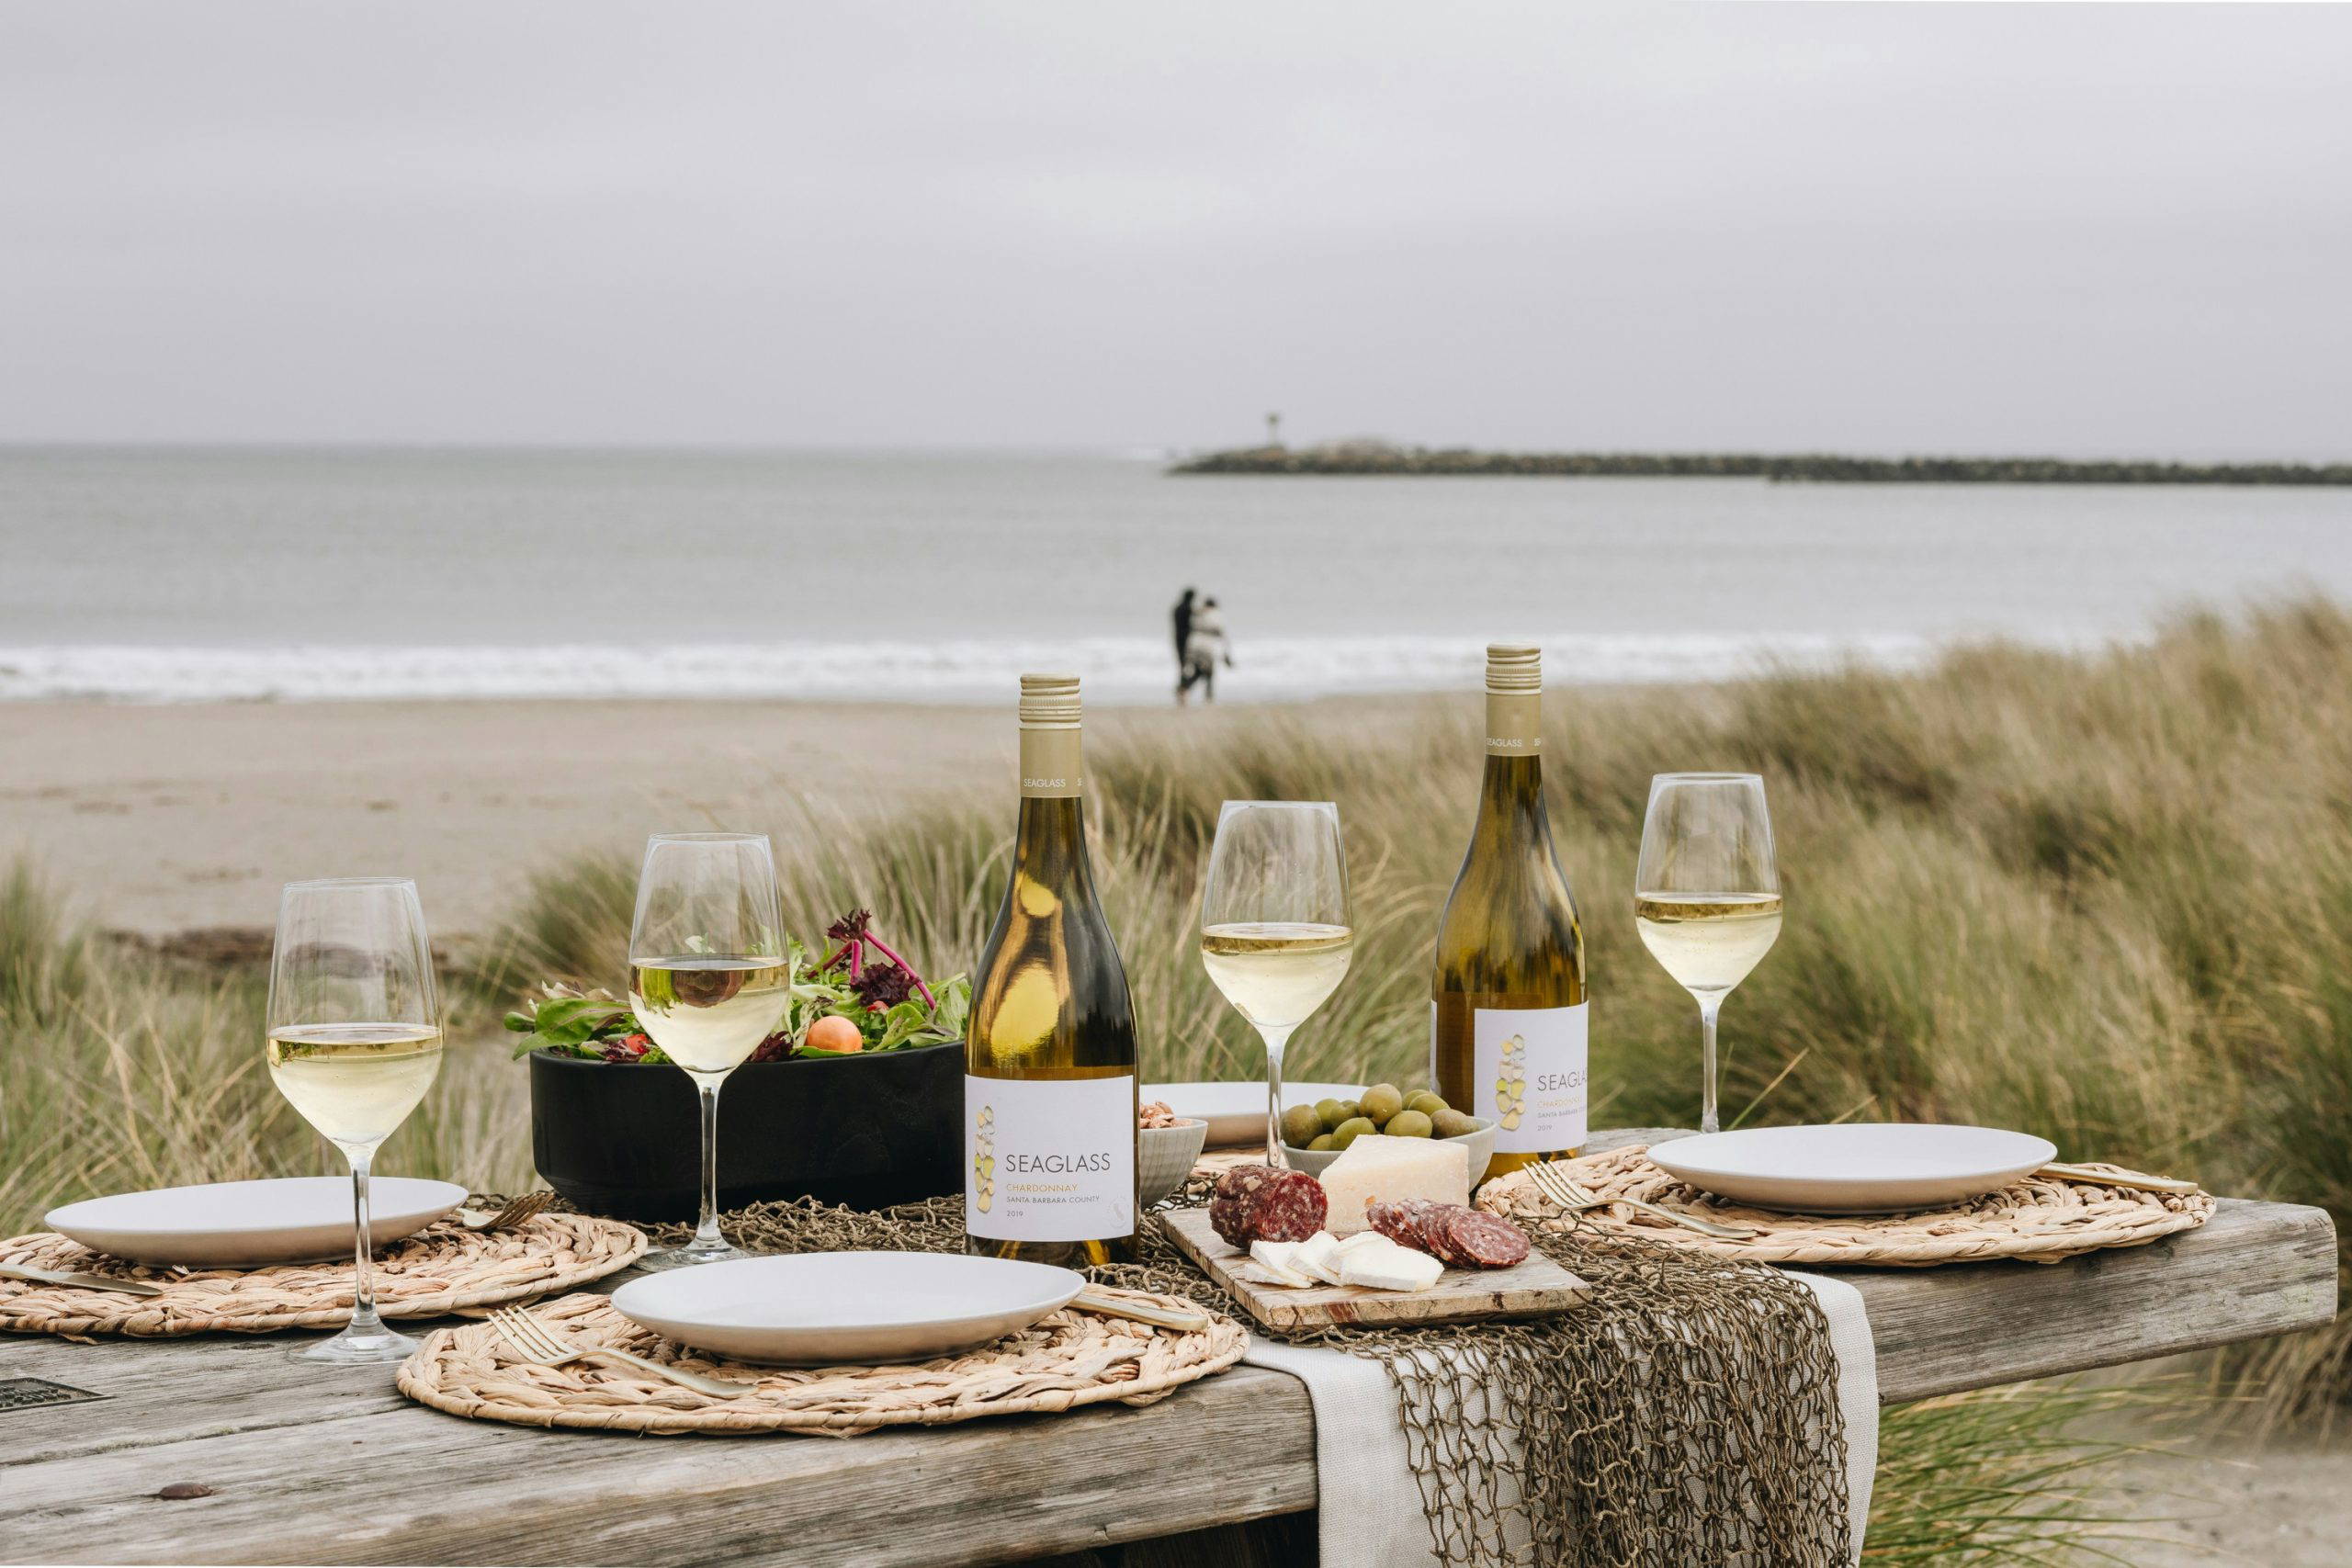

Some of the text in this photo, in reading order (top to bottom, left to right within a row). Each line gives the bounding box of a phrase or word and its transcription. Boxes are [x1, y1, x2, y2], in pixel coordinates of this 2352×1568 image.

[1023, 778, 1066, 787] SEAGLASS
[1537, 1123, 1553, 1132] 2019
[1006, 1153, 1110, 1173] SEAGLASS
[1006, 1183, 1078, 1193] CHARDONNAY
[1006, 1195, 1100, 1204] SANTA BARBARA COUNTY
[1006, 1210, 1024, 1218] 2019
